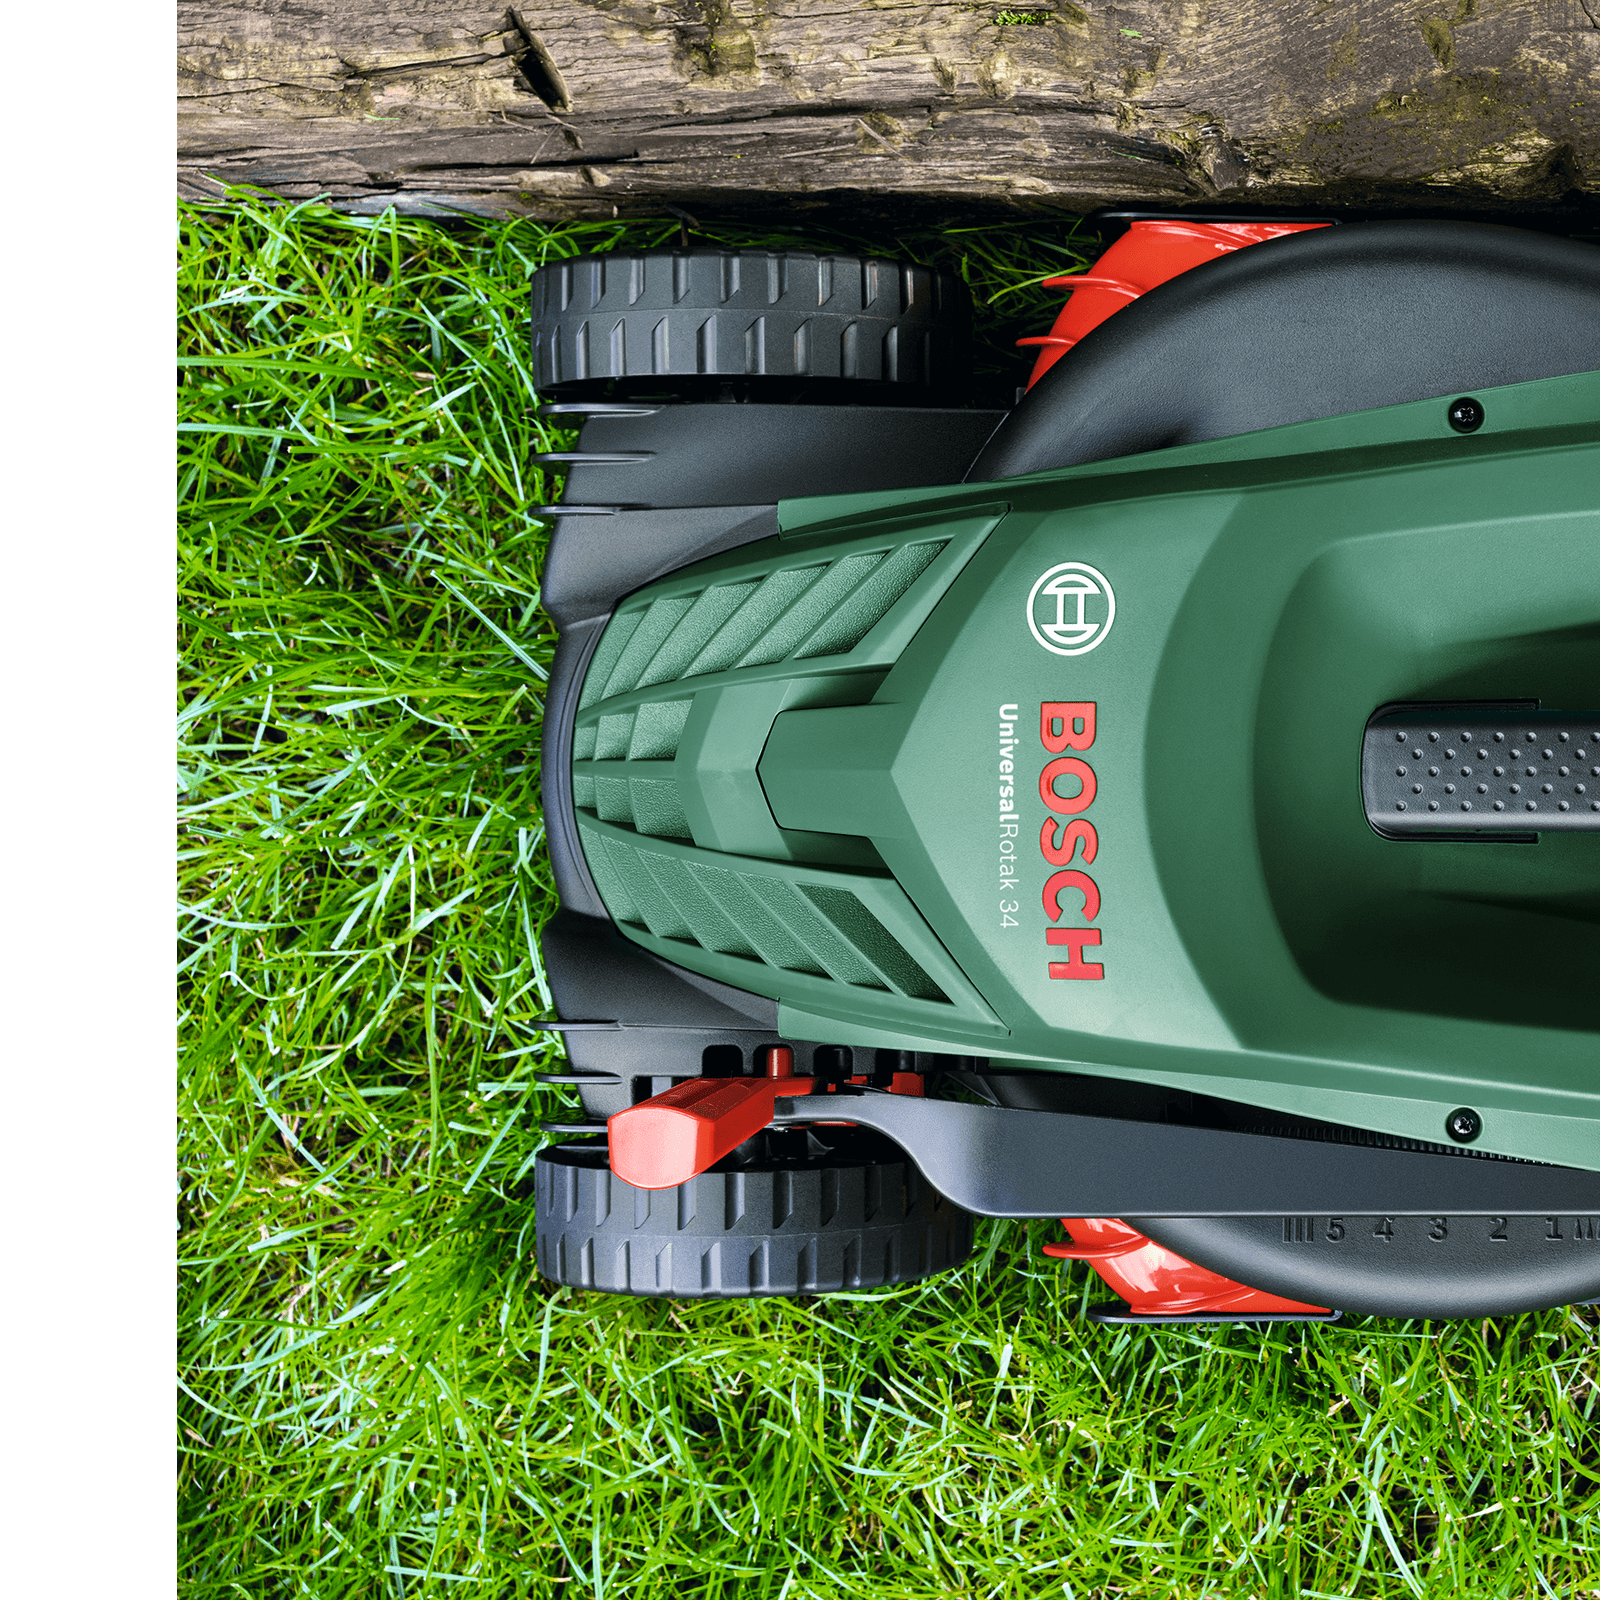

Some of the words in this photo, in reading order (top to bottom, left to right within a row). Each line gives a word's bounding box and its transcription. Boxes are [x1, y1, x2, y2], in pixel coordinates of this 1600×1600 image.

[999, 703, 1020, 891] UniversalRotak
[1038, 701, 1105, 980] BOSCH
[999, 899, 1020, 929] 34
[1326, 1216, 1345, 1243] 5
[1373, 1216, 1395, 1243] 4
[1428, 1216, 1448, 1243] 3
[1489, 1216, 1508, 1242] 2
[1545, 1216, 1564, 1241] 1
